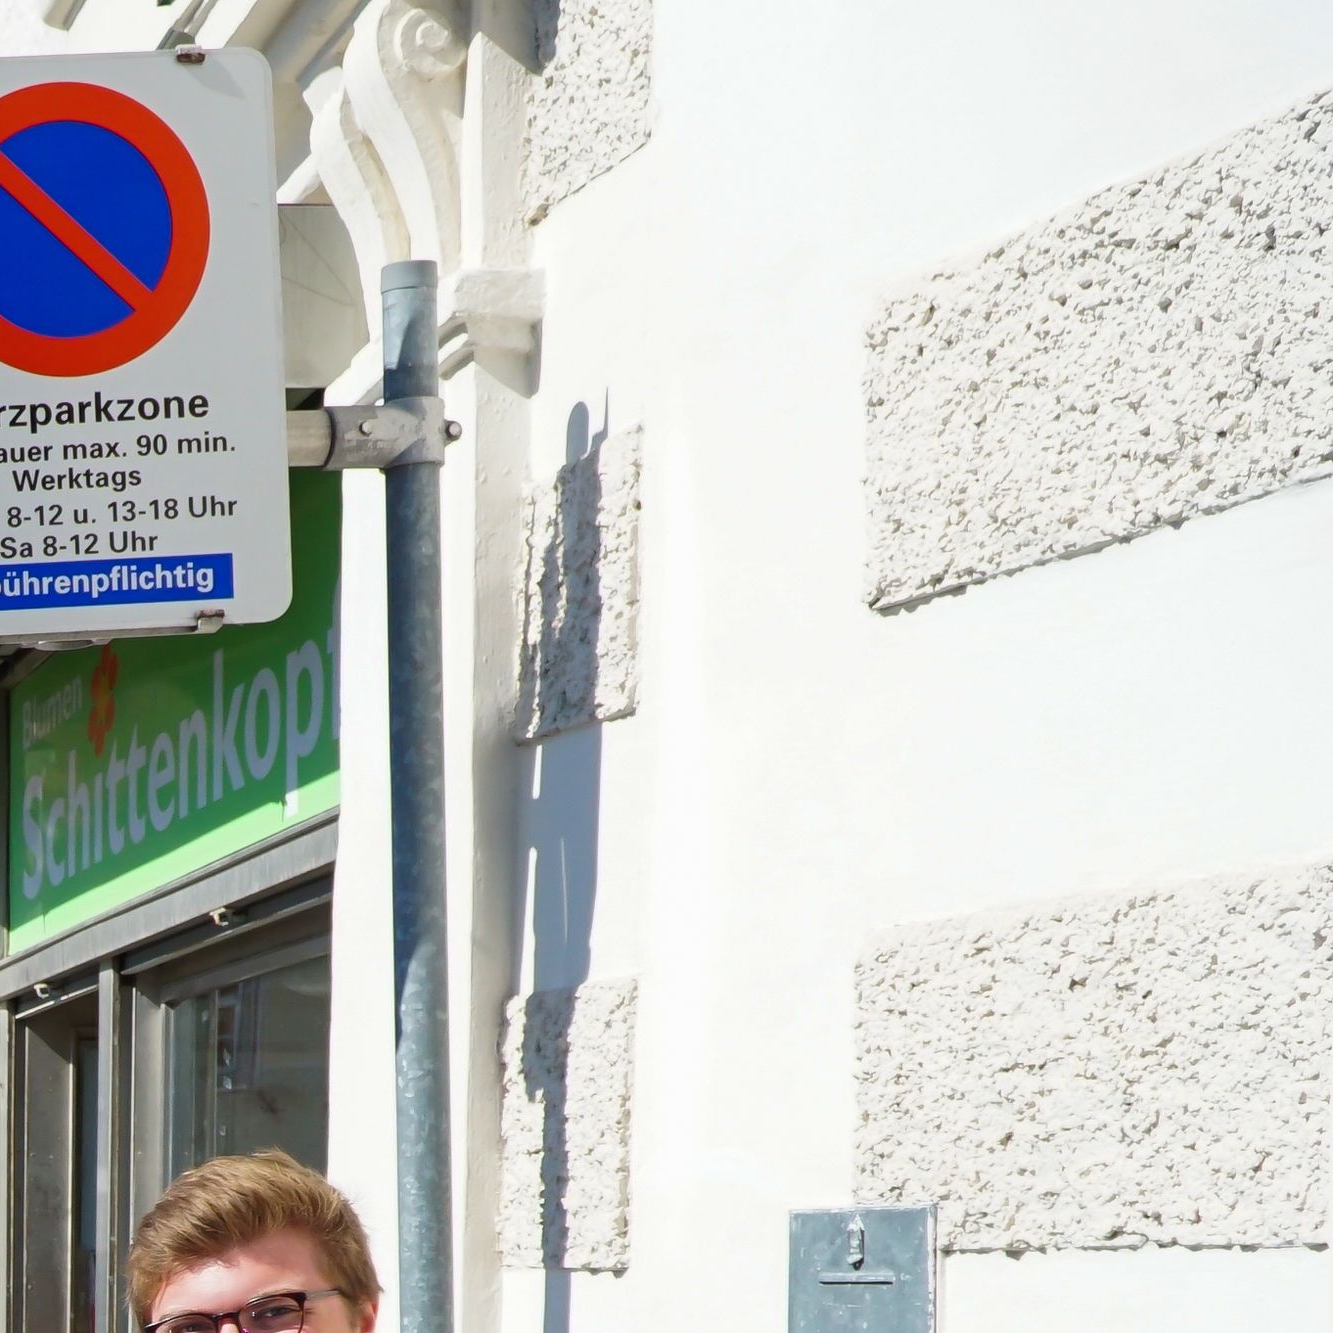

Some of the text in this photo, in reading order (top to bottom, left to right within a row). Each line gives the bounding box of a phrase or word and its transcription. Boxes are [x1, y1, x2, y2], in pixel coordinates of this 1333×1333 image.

[62, 440, 128, 461] max.
[135, 433, 168, 457] 90
[176, 430, 236, 454] min.
[12, 467, 142, 492] Werktags
[6, 504, 64, 528] 8-12
[73, 507, 97, 525] u.
[107, 498, 180, 523] 13-18
[188, 495, 238, 518] Uhr
[0, 530, 159, 559] Sa 8-12 Uhr
